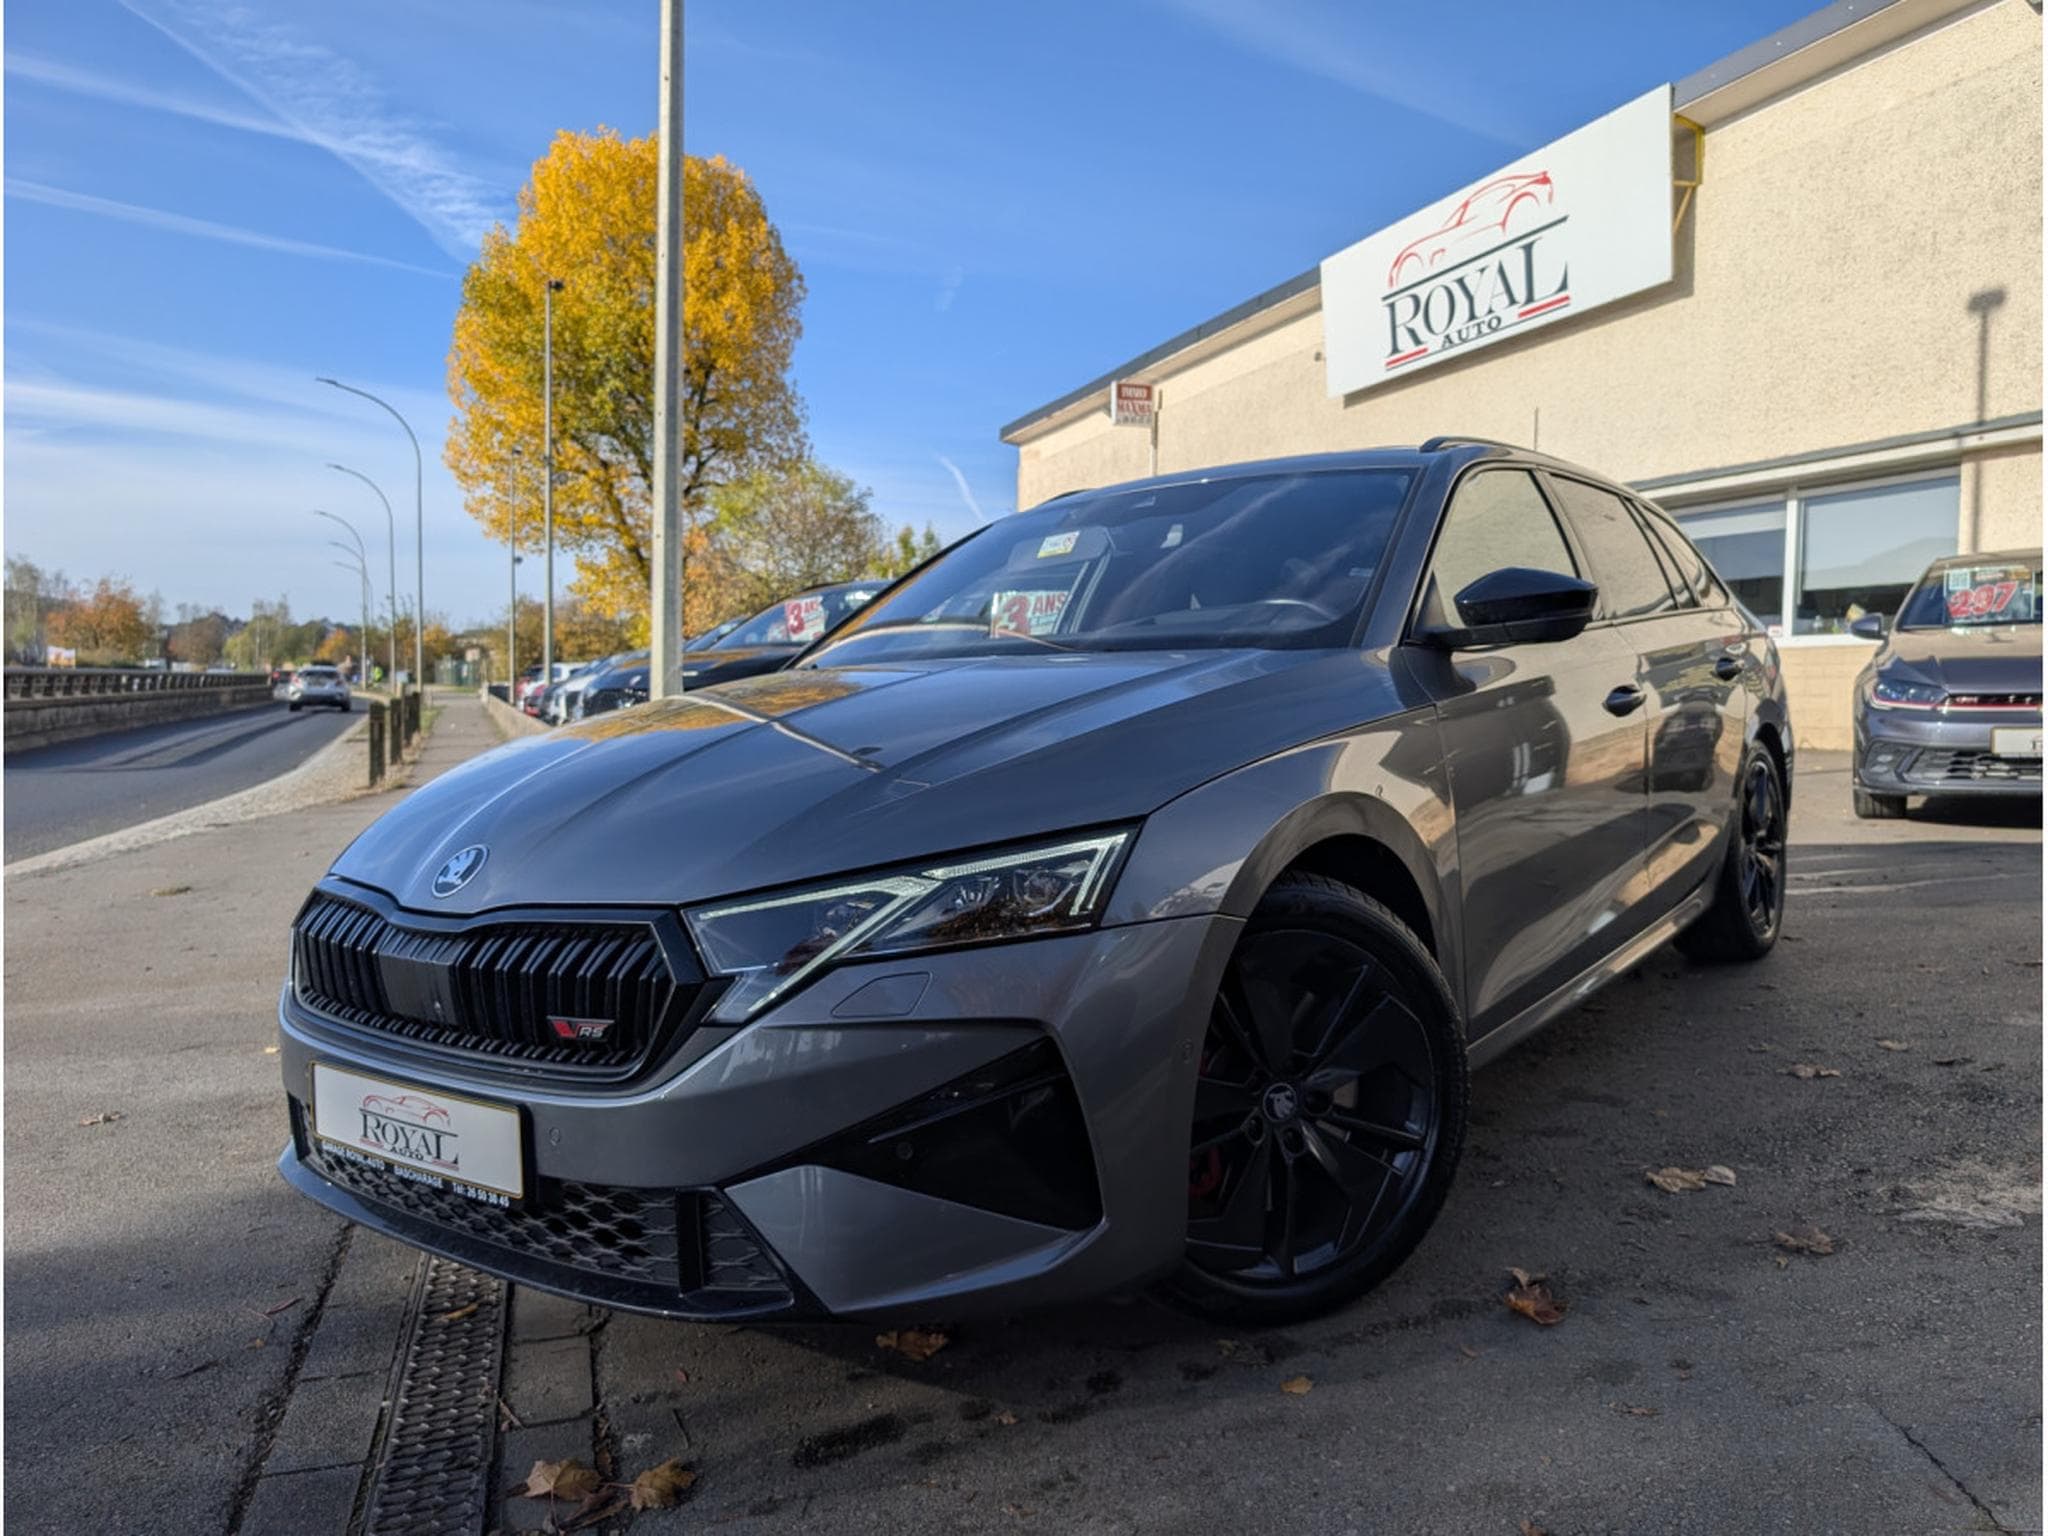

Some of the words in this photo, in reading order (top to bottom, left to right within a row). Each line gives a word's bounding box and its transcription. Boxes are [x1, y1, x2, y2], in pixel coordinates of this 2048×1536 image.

[1386, 236, 1569, 357] ROYAL
[1440, 314, 1503, 350] AUTO
[787, 602, 805, 635] 3
[1003, 595, 1030, 636] 3
[360, 1112, 459, 1165] ROYAL
[389, 1145, 424, 1161] AUTO
